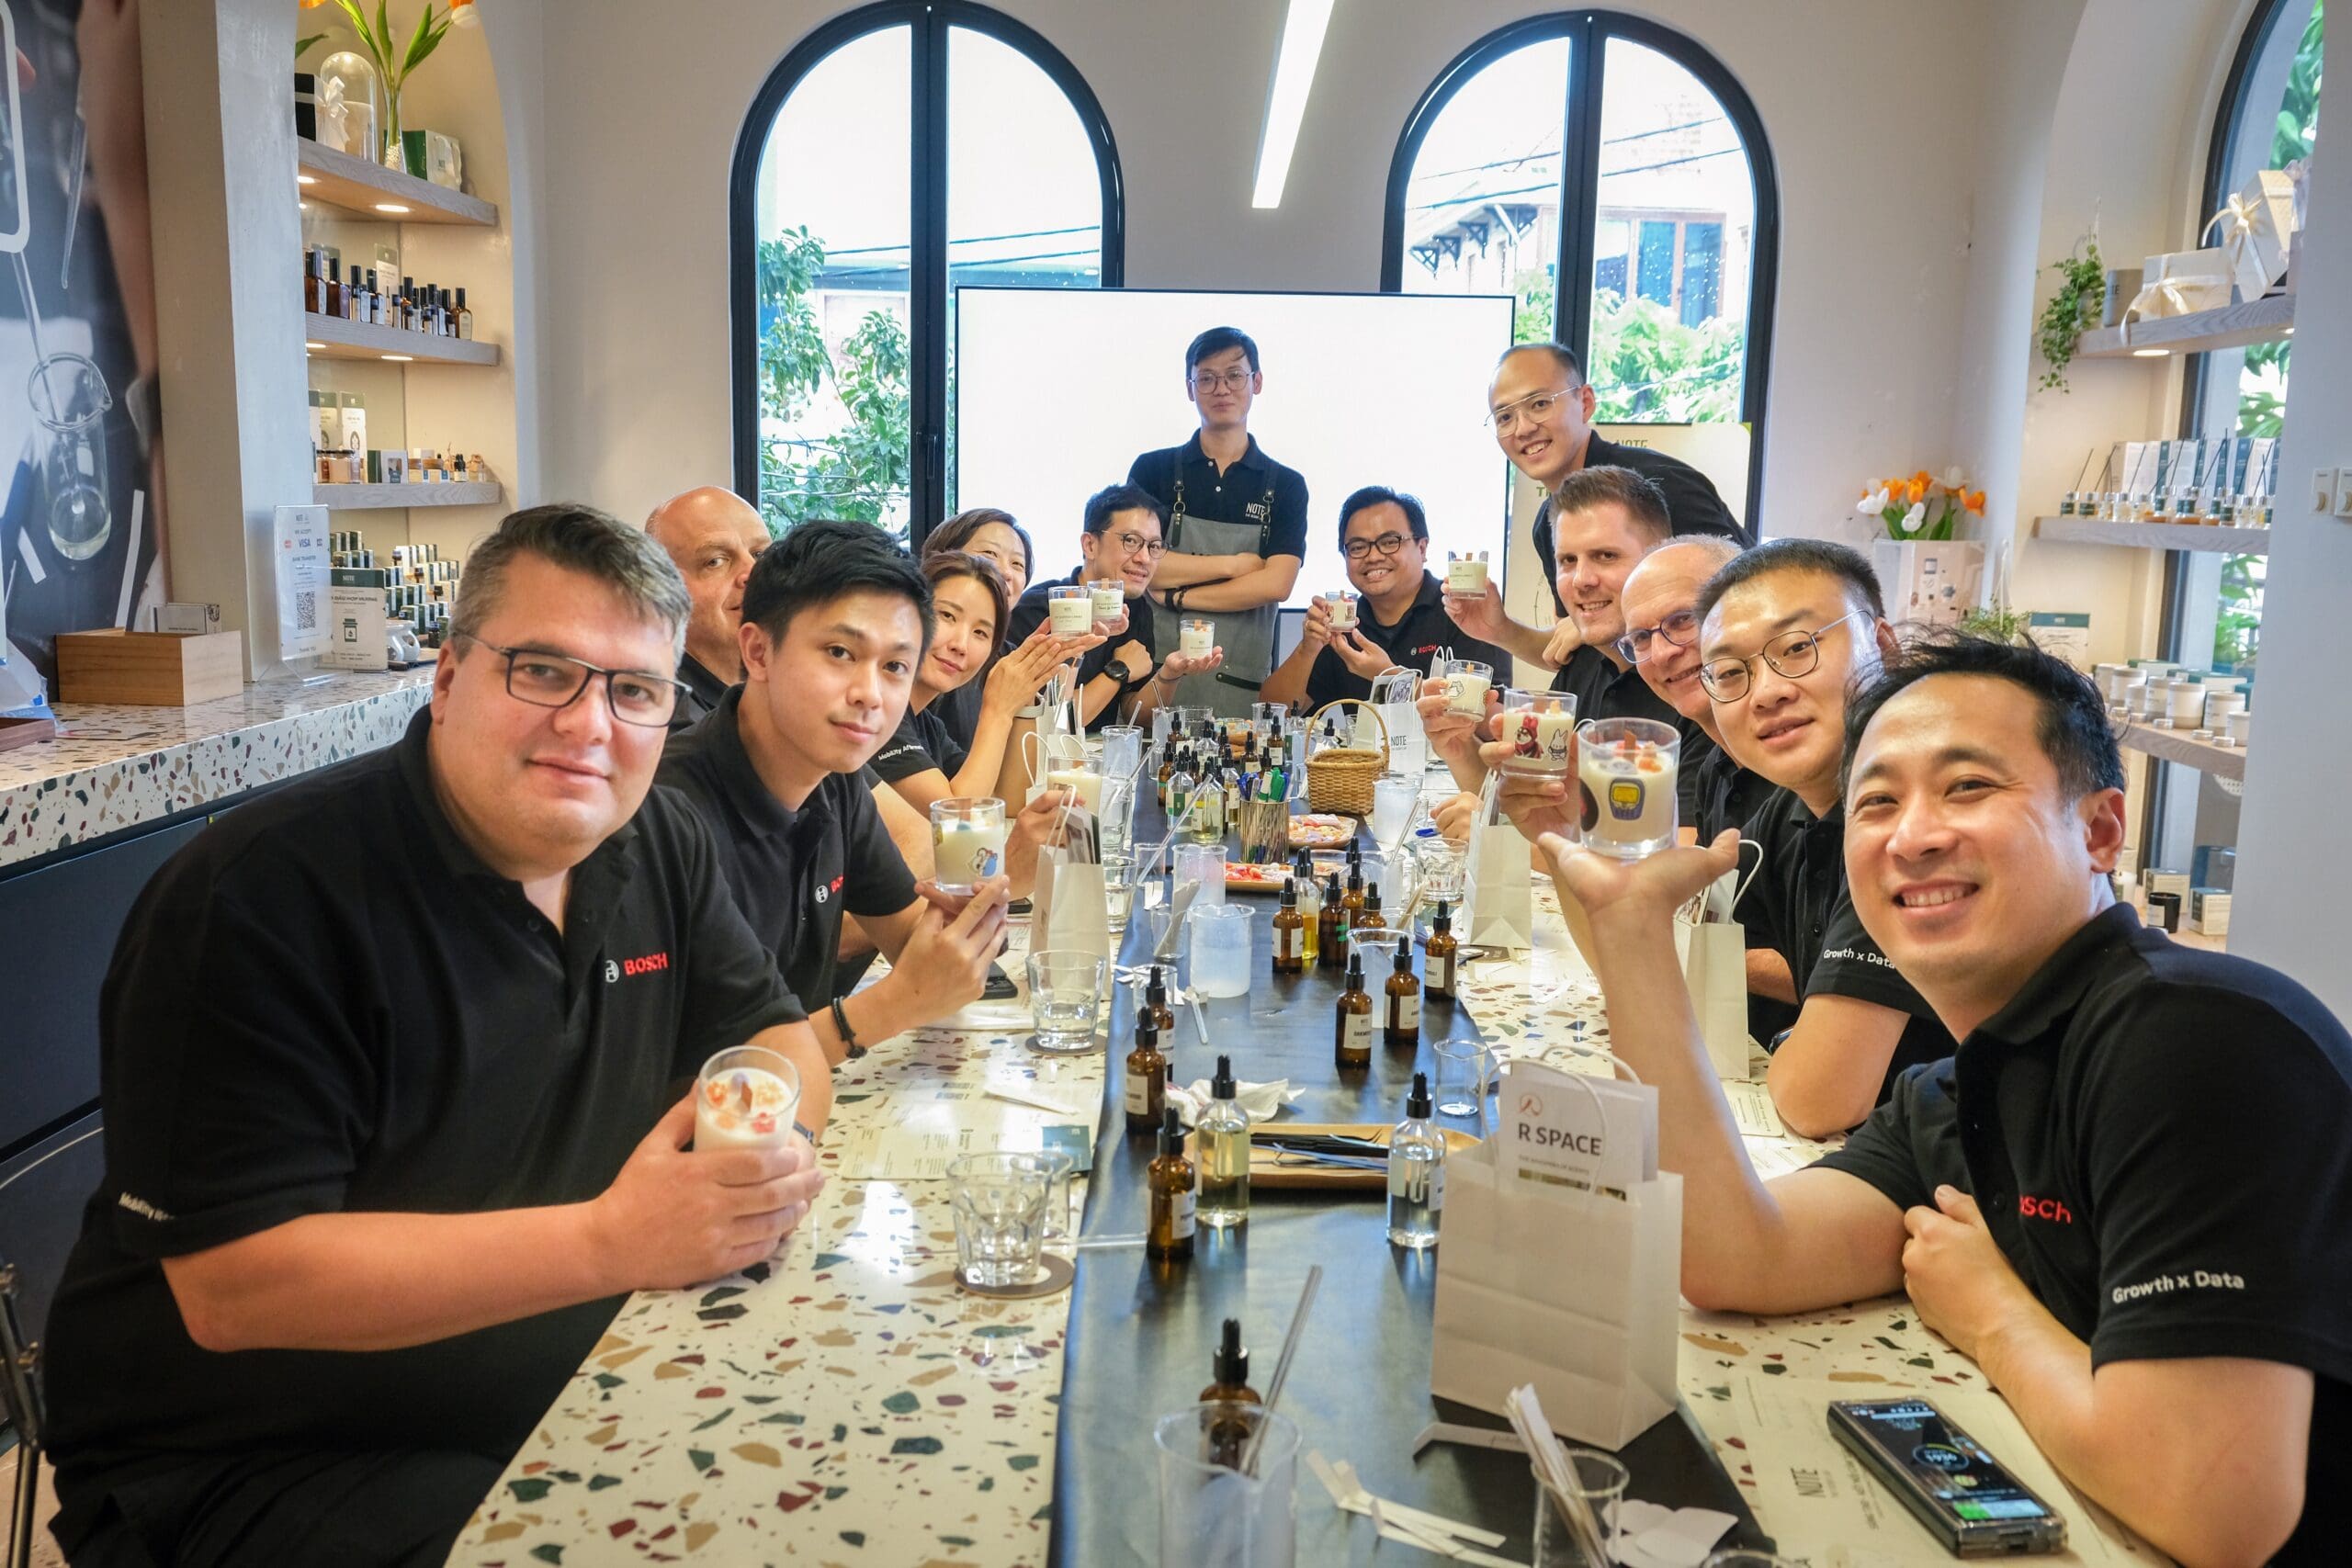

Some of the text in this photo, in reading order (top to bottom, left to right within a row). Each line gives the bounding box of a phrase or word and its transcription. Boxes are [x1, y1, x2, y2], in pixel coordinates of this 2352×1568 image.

[1246, 502, 1266, 516] NOTE
[299, 538, 311, 548] VISA
[1391, 736, 1408, 746] NOTE
[1823, 948, 1855, 959] Growth
[1857, 952, 1866, 961] x
[624, 953, 669, 976] BOSCH
[1518, 1122, 1602, 1156] R SPACE
[2113, 1269, 2245, 1304] Growth x Data
